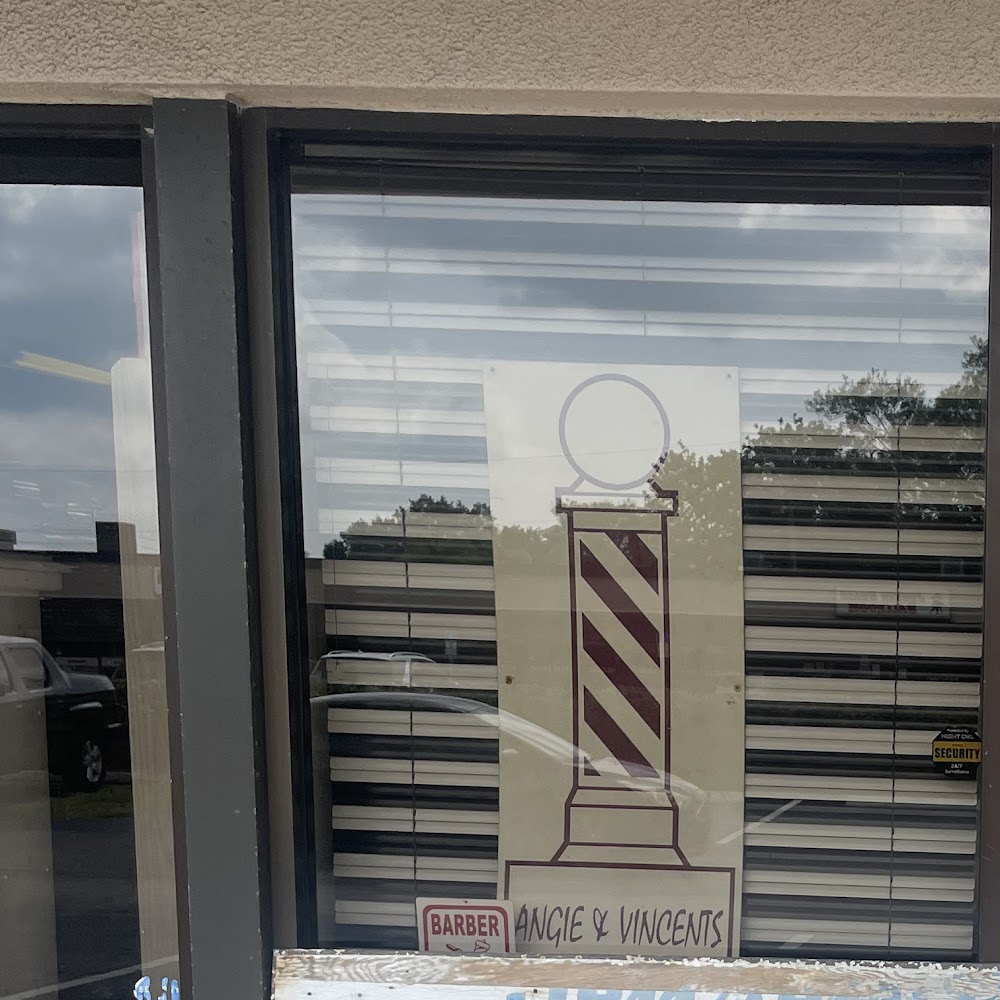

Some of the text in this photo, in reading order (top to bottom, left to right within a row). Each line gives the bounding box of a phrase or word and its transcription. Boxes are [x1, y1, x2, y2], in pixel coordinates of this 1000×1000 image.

[935, 748, 980, 759] SECURITY
[431, 913, 500, 937] BARBER
[514, 904, 585, 948] ANGIE
[620, 906, 724, 948] VINCENTS
